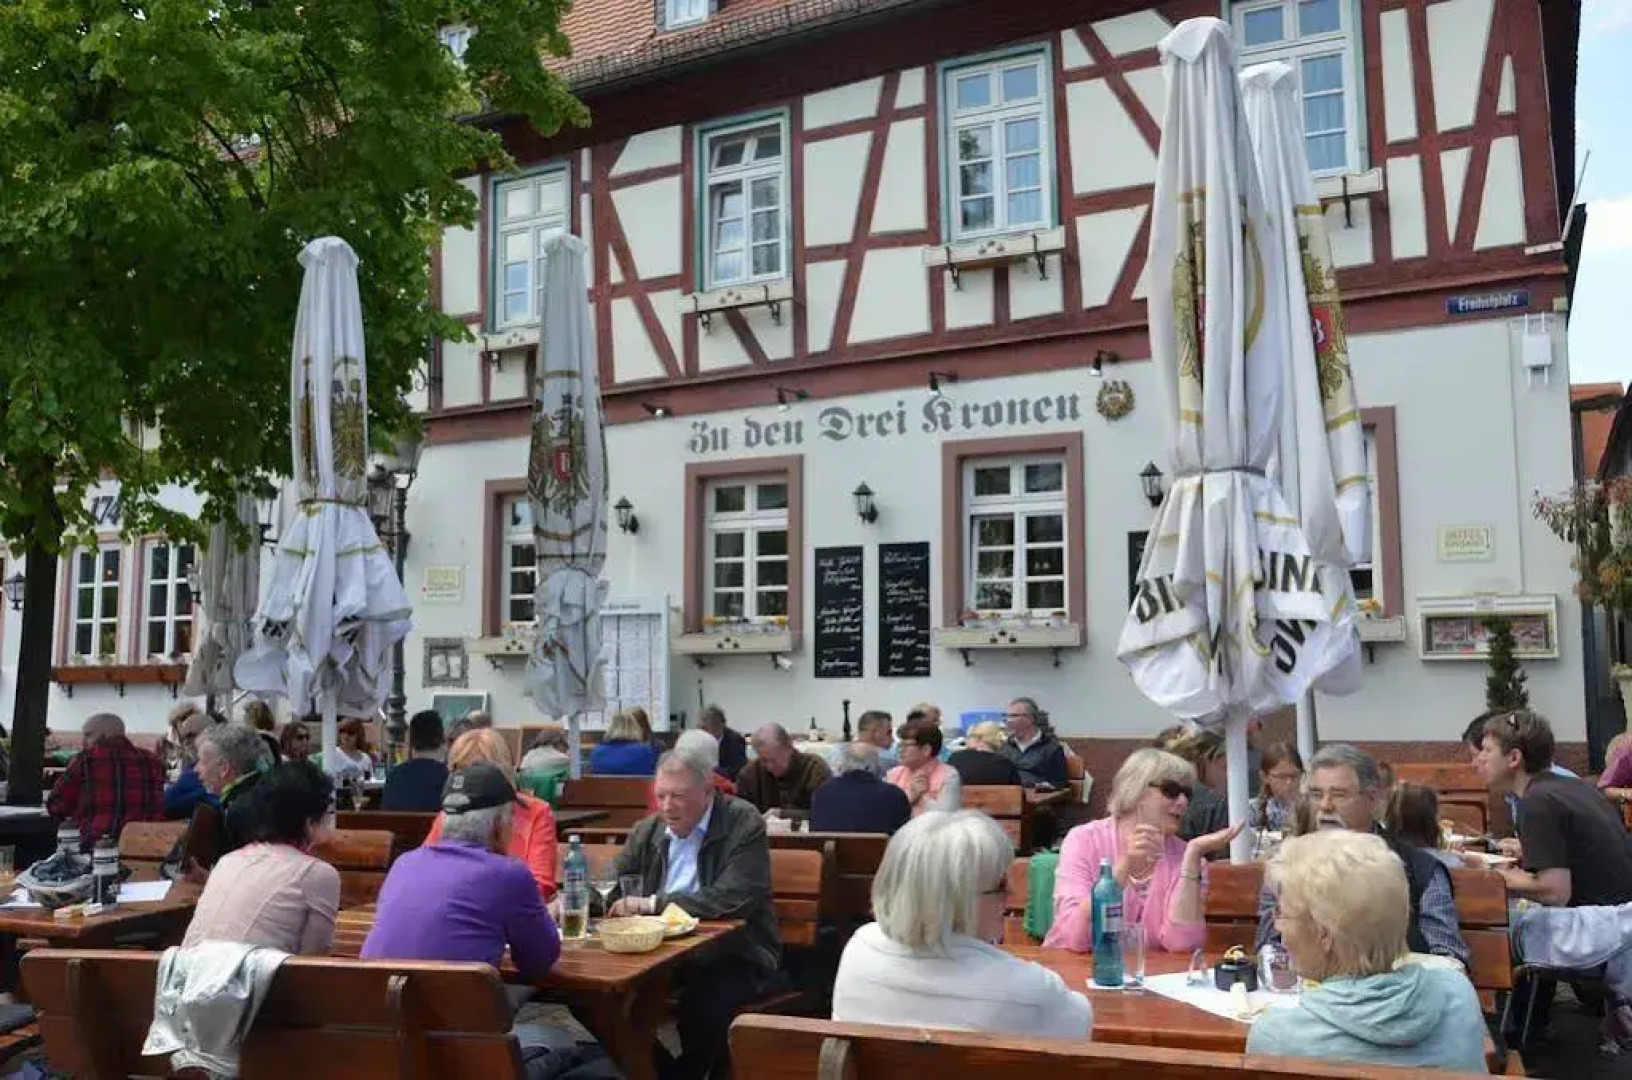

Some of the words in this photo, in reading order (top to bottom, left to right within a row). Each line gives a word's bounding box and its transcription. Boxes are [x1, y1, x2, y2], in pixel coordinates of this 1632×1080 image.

[687, 420, 729, 454] Zu
[744, 415, 804, 448] den
[818, 401, 907, 441] Drei
[921, 391, 1081, 434] Kronen
